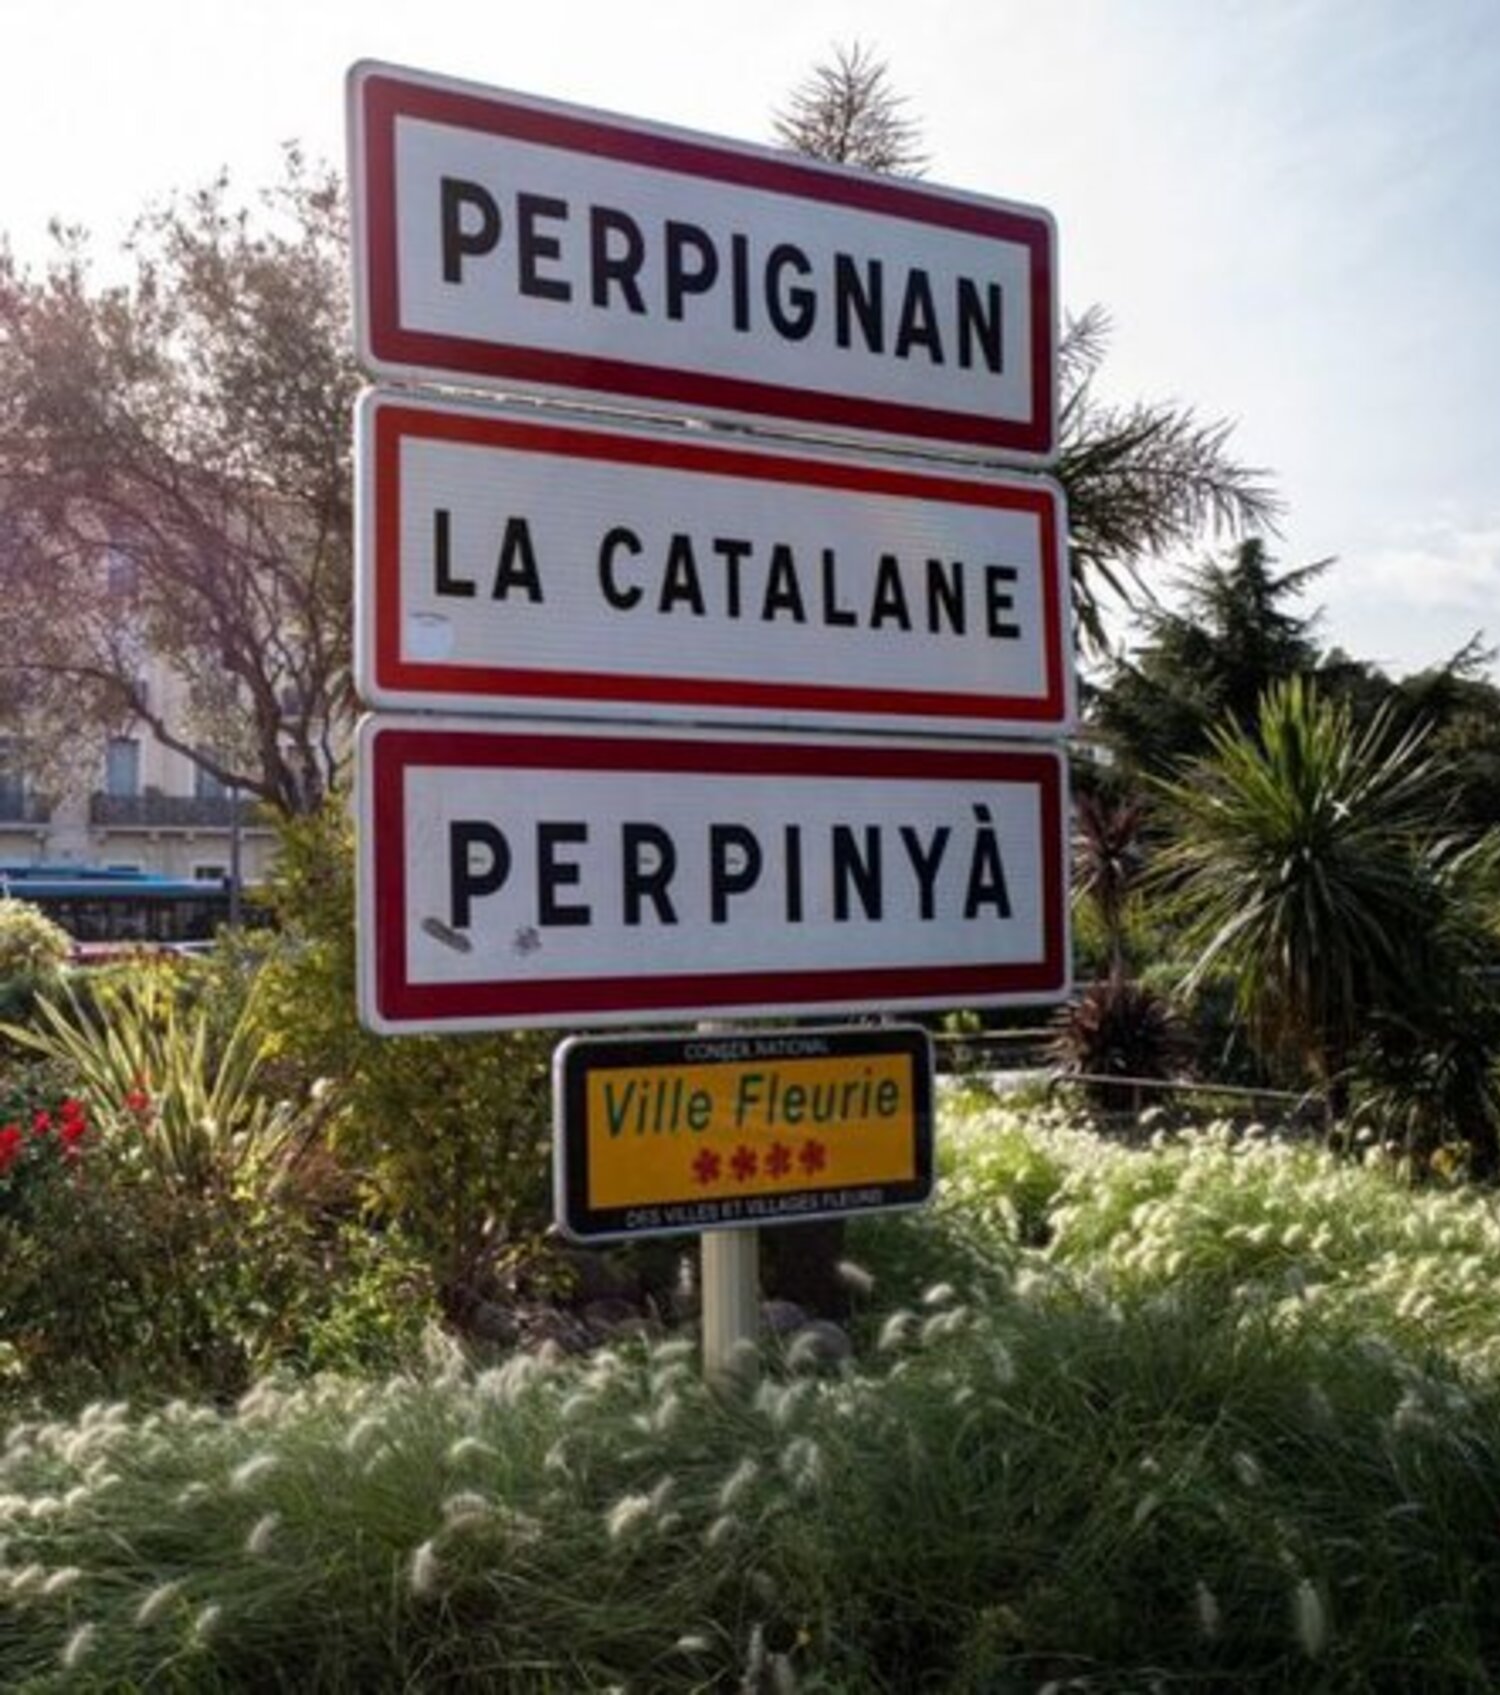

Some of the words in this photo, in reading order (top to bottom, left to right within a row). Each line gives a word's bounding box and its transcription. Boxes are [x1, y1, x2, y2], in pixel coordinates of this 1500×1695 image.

[440, 176, 1004, 375] PERPIGNAN
[434, 510, 543, 604] LA
[598, 526, 1021, 639] CATALANE
[449, 803, 1012, 928] PERPINYÀ
[604, 1077, 713, 1138] Ville
[735, 1067, 899, 1127] Fleurie
